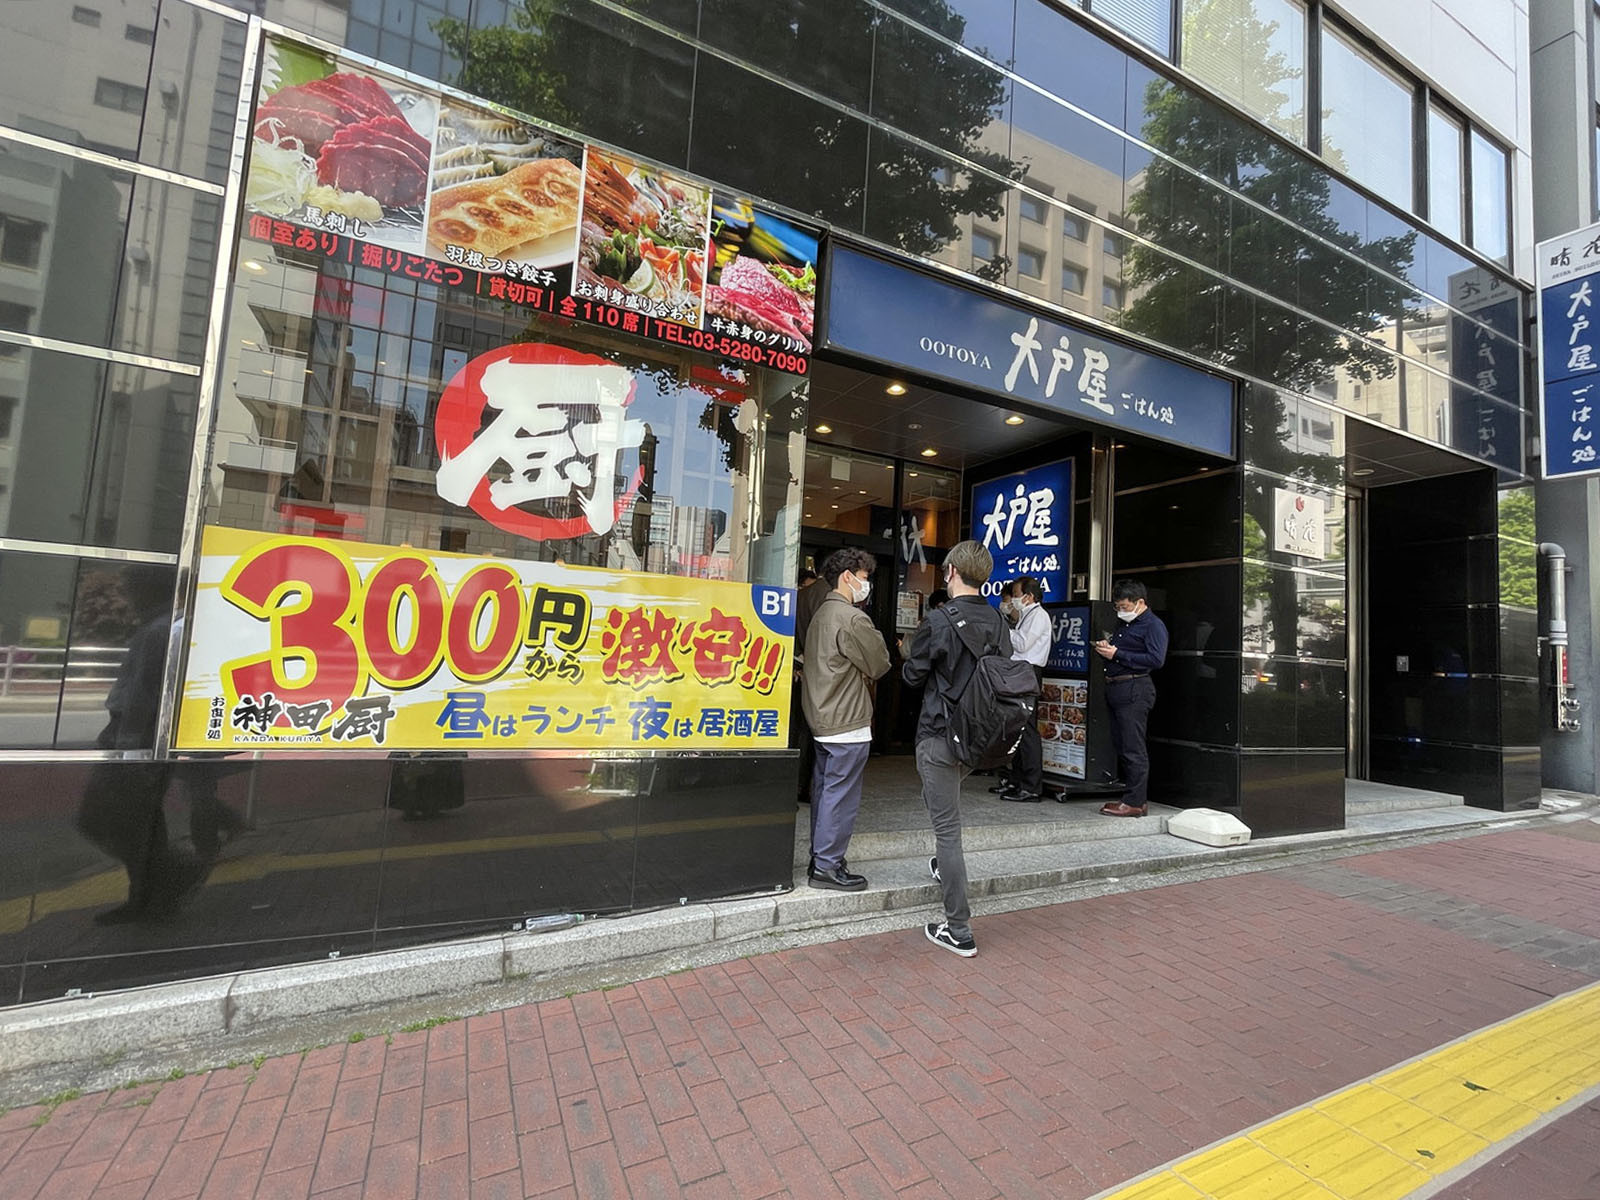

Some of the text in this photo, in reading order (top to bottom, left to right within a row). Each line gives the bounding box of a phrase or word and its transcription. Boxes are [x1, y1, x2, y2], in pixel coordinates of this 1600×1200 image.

[302, 205, 367, 238] 馬刺し
[446, 244, 558, 286] 羽根つき餃子
[249, 214, 339, 255] 個室あり
[362, 243, 464, 286] 掘りごたつ
[489, 276, 545, 308] 貸切可
[655, 319, 807, 375] TEL:03-5280-7090
[578, 281, 698, 325] お刺身盛り合わせ
[710, 317, 806, 355] 牛赤身のグリル
[919, 336, 993, 370] OOTOYA
[1121, 392, 1176, 426] ごはん処
[436, 356, 646, 536] 厨
[1007, 553, 1060, 574] ごはん処
[762, 590, 791, 617] B1
[980, 576, 1051, 597] OOA
[225, 541, 523, 733] 300
[527, 586, 589, 649] 円
[525, 649, 584, 683] から
[207, 696, 225, 740] お食事処
[233, 694, 396, 744] 神田厨
[436, 692, 779, 741] 昼はランチ 夜は居酒屋
[279, 735, 322, 743] KURIYA
